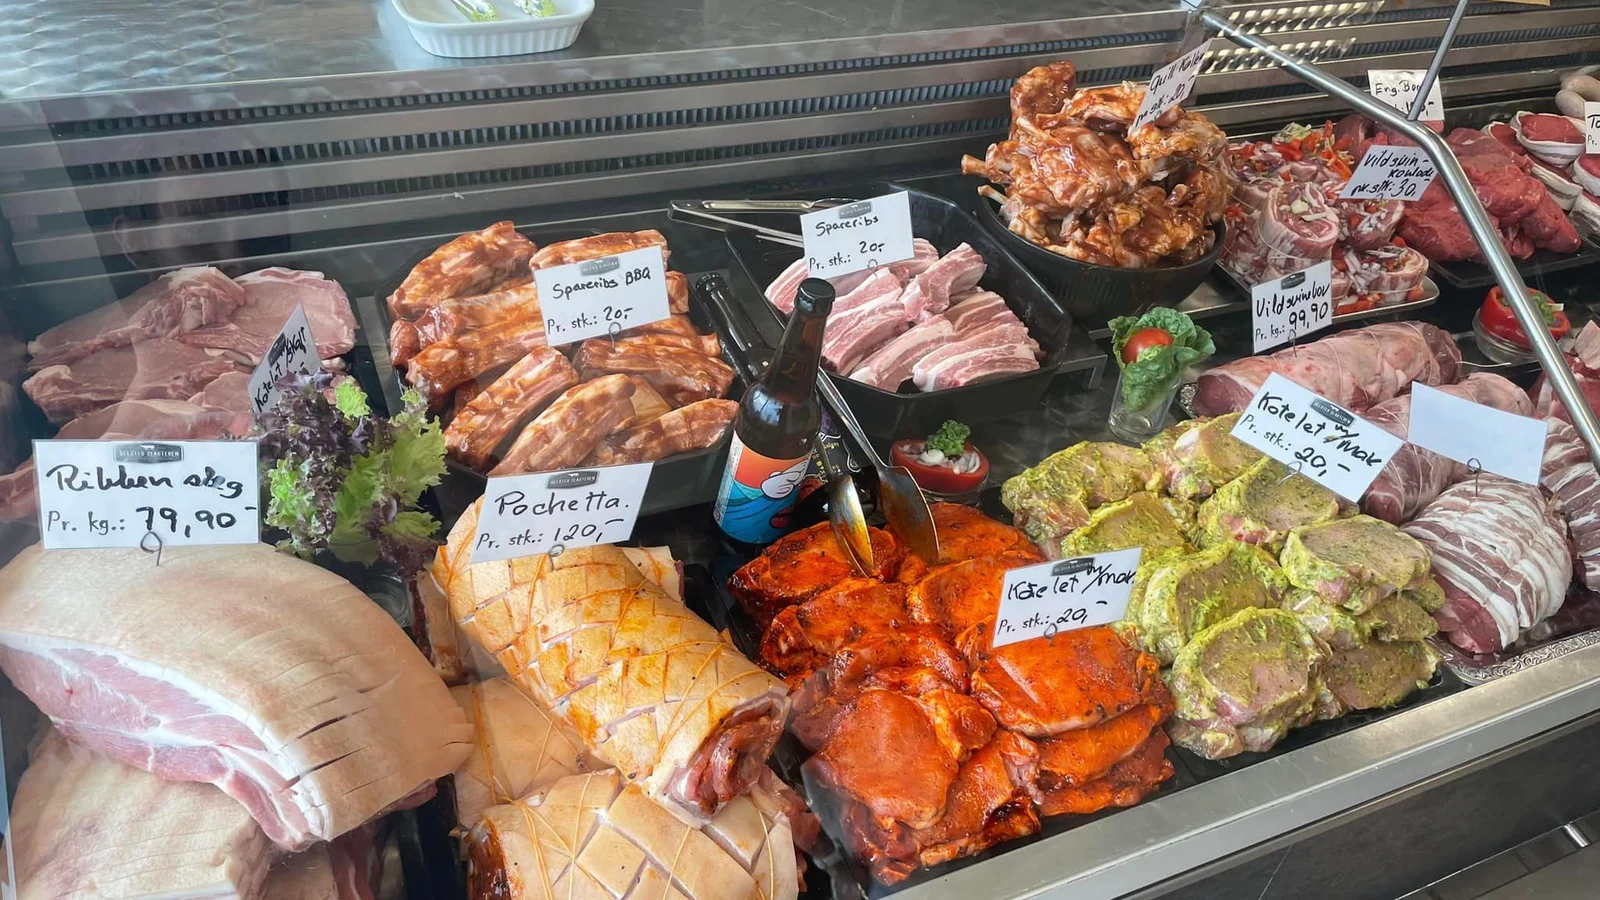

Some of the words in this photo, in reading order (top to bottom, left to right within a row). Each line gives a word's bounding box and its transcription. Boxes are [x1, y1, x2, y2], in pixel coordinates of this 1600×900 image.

[1375, 82, 1400, 97] Eng.
[1587, 134, 1597, 146] Pr.
[815, 215, 879, 237] Spareribs
[809, 257, 825, 272] Pr.
[829, 251, 851, 266] stk.:
[552, 277, 619, 301] Spareribs
[625, 266, 651, 286] BBQ
[547, 318, 566, 335] Pr.
[571, 312, 598, 329] stk.:
[1255, 327, 1267, 341] Pr.
[1271, 324, 1285, 338] kg.:
[1289, 301, 1329, 331] 99,90
[1240, 413, 1257, 434] Pr.
[1263, 432, 1292, 451] stk.:
[46, 464, 173, 492] Ribben
[48, 510, 77, 532] Pr.
[89, 510, 126, 536] kg.:
[476, 532, 499, 550] Pr.
[508, 528, 544, 546] stk.:
[997, 619, 1016, 635] Pr.
[1022, 612, 1050, 630] stk.:
